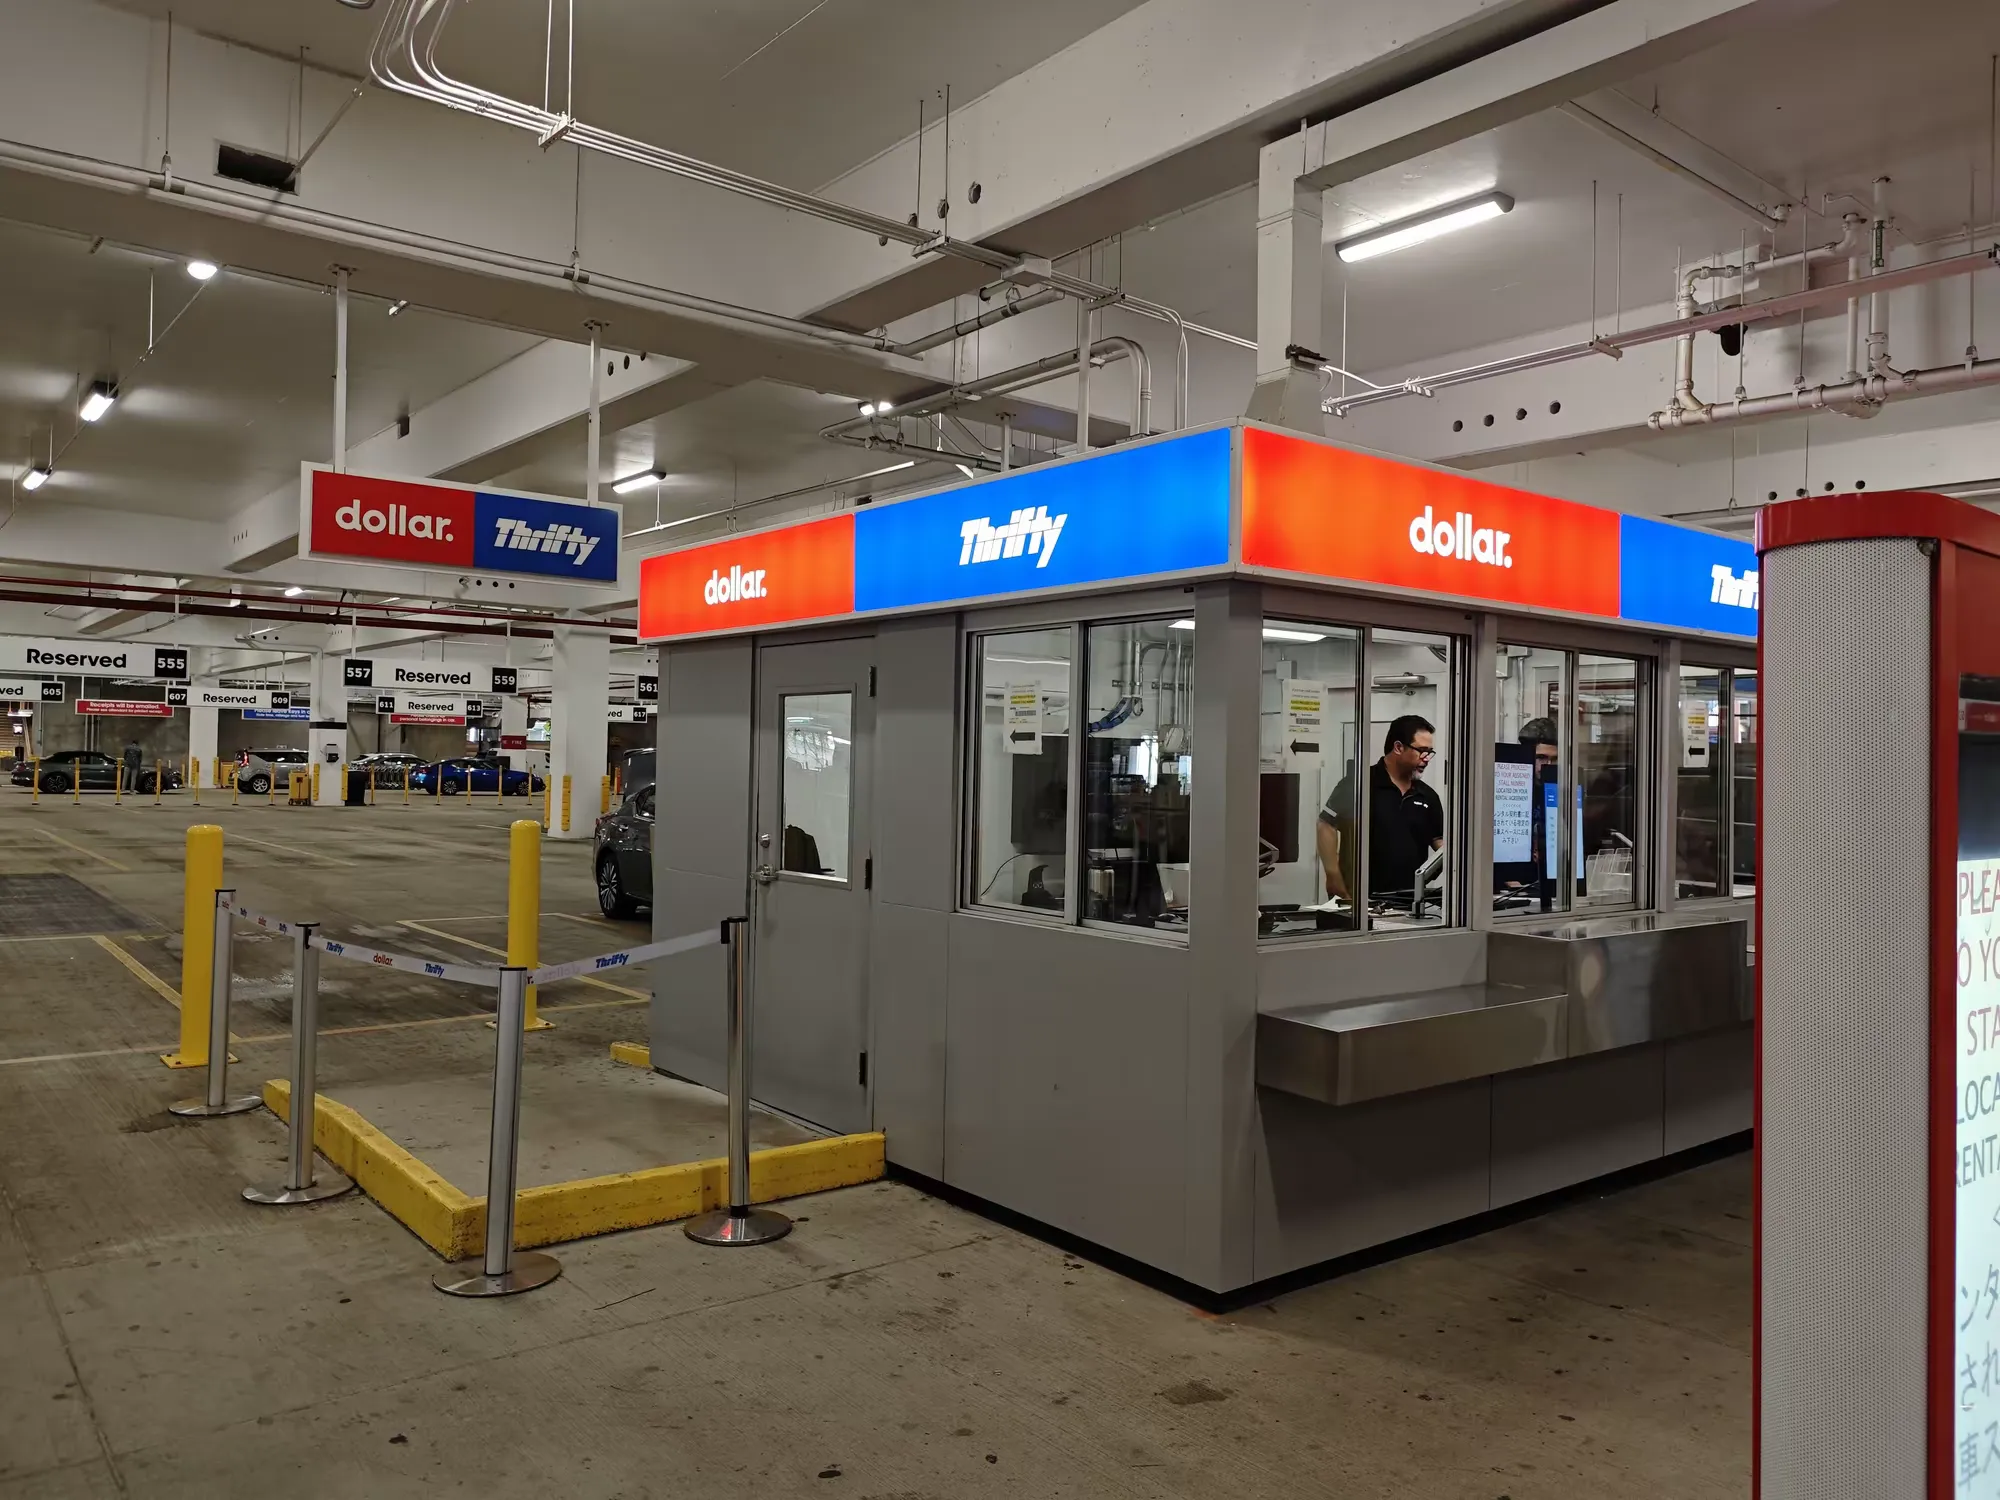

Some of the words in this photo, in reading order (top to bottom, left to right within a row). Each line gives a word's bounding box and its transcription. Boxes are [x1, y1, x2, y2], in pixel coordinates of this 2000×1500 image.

[335, 499, 454, 542] dollar.
[493, 517, 600, 566] Thrifty
[1409, 505, 1512, 568] dollar.
[704, 564, 768, 605] dollar.
[959, 505, 1067, 568] Thrifty
[26, 648, 127, 669] Reserved
[157, 657, 185, 669] 555
[346, 667, 371, 679] 557
[395, 668, 471, 686] Reserved
[494, 675, 516, 686] 559
[43, 688, 62, 696] 605
[640, 682, 658, 693] 561
[169, 692, 187, 701] 607
[203, 693, 257, 704] Reserved
[272, 696, 288, 704] 609
[379, 701, 394, 709] 611
[408, 701, 454, 712] Reserved
[467, 704, 481, 712] 613
[325, 941, 345, 956] Thrifty
[425, 962, 445, 977] Thrifty
[595, 953, 630, 969] Thrifty
